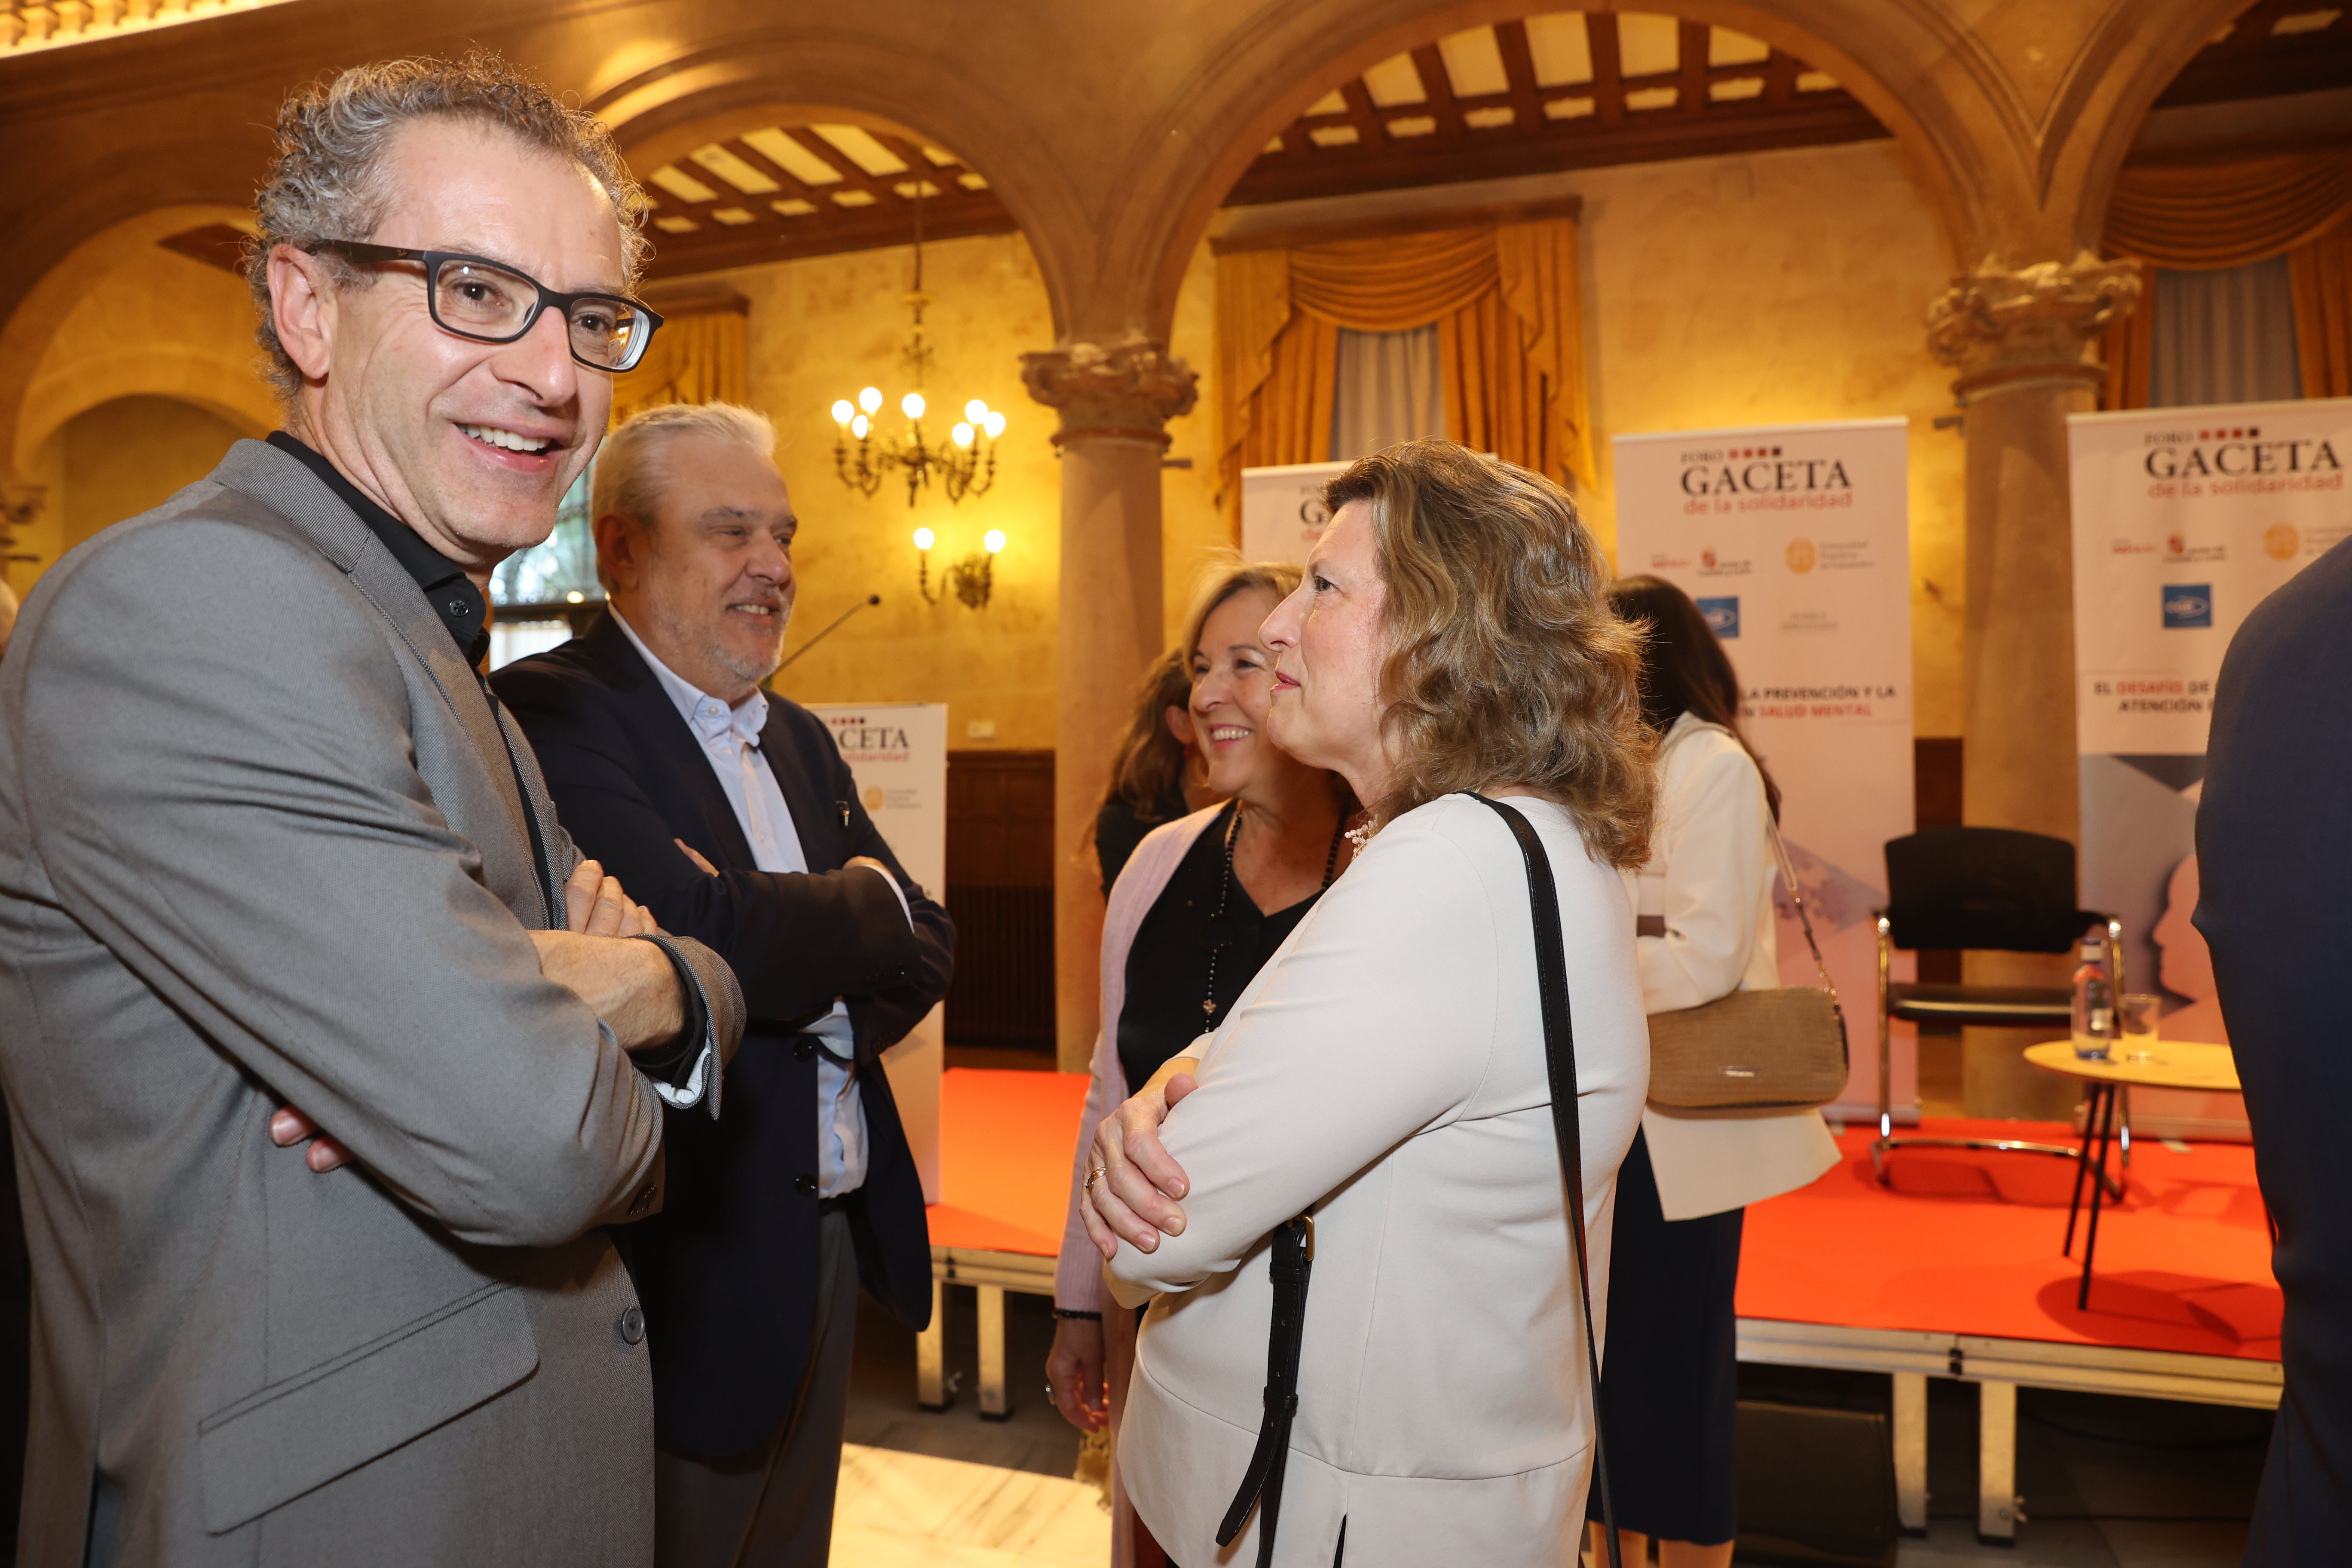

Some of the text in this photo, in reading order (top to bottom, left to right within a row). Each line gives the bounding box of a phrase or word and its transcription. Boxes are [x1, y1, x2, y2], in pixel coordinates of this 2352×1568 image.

[2144, 432, 2192, 444] FORO
[1681, 450, 1723, 463] FORO
[2144, 439, 2342, 480] GACETA
[1681, 459, 1851, 497] GACETA
[2148, 473, 2343, 499] de la solidaridad
[1684, 492, 1853, 514] de la solidaridad
[1764, 686, 1859, 700] PREVENCIÓN
[1862, 687, 1871, 697] Y
[1876, 686, 1896, 697] LA
[2094, 681, 2110, 695] EL
[2188, 680, 2209, 695] DE
[1760, 705, 1806, 718] SALUD
[1811, 704, 1872, 717] MENTAL
[2119, 697, 2202, 713] ATENCIÓN
[839, 726, 909, 750] CETA
